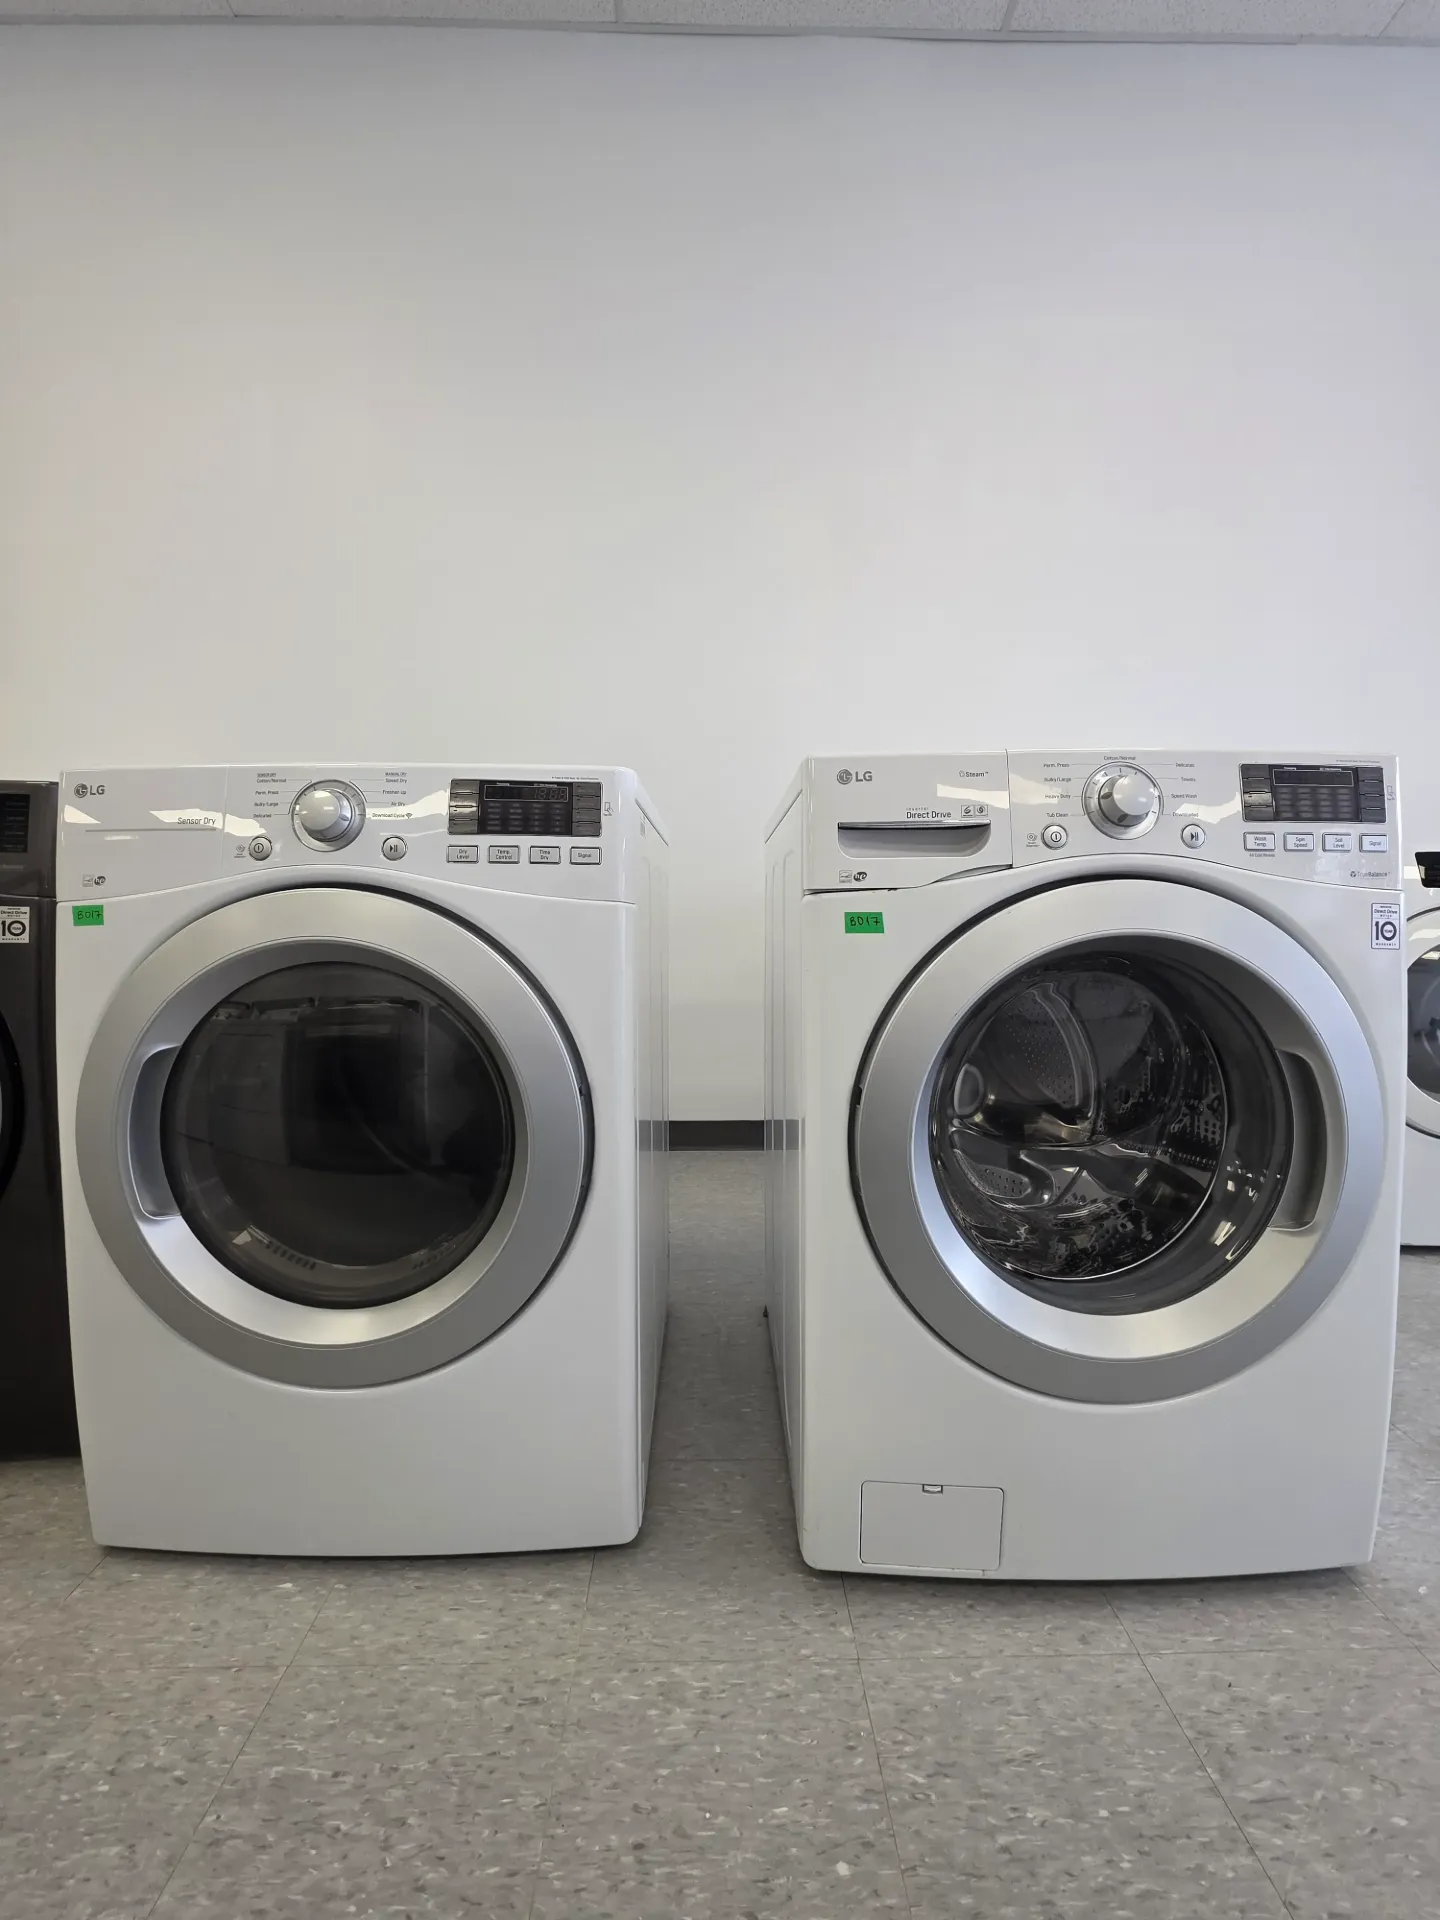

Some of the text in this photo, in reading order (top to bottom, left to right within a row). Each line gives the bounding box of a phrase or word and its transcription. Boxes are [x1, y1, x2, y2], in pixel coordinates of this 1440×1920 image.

[855, 771, 873, 782] LG
[89, 785, 106, 796] LG
[906, 811, 952, 819] Direct Drive
[177, 816, 216, 827] Sensor Dry
[1, 920, 27, 937] 10
[1375, 921, 1397, 941] 10
